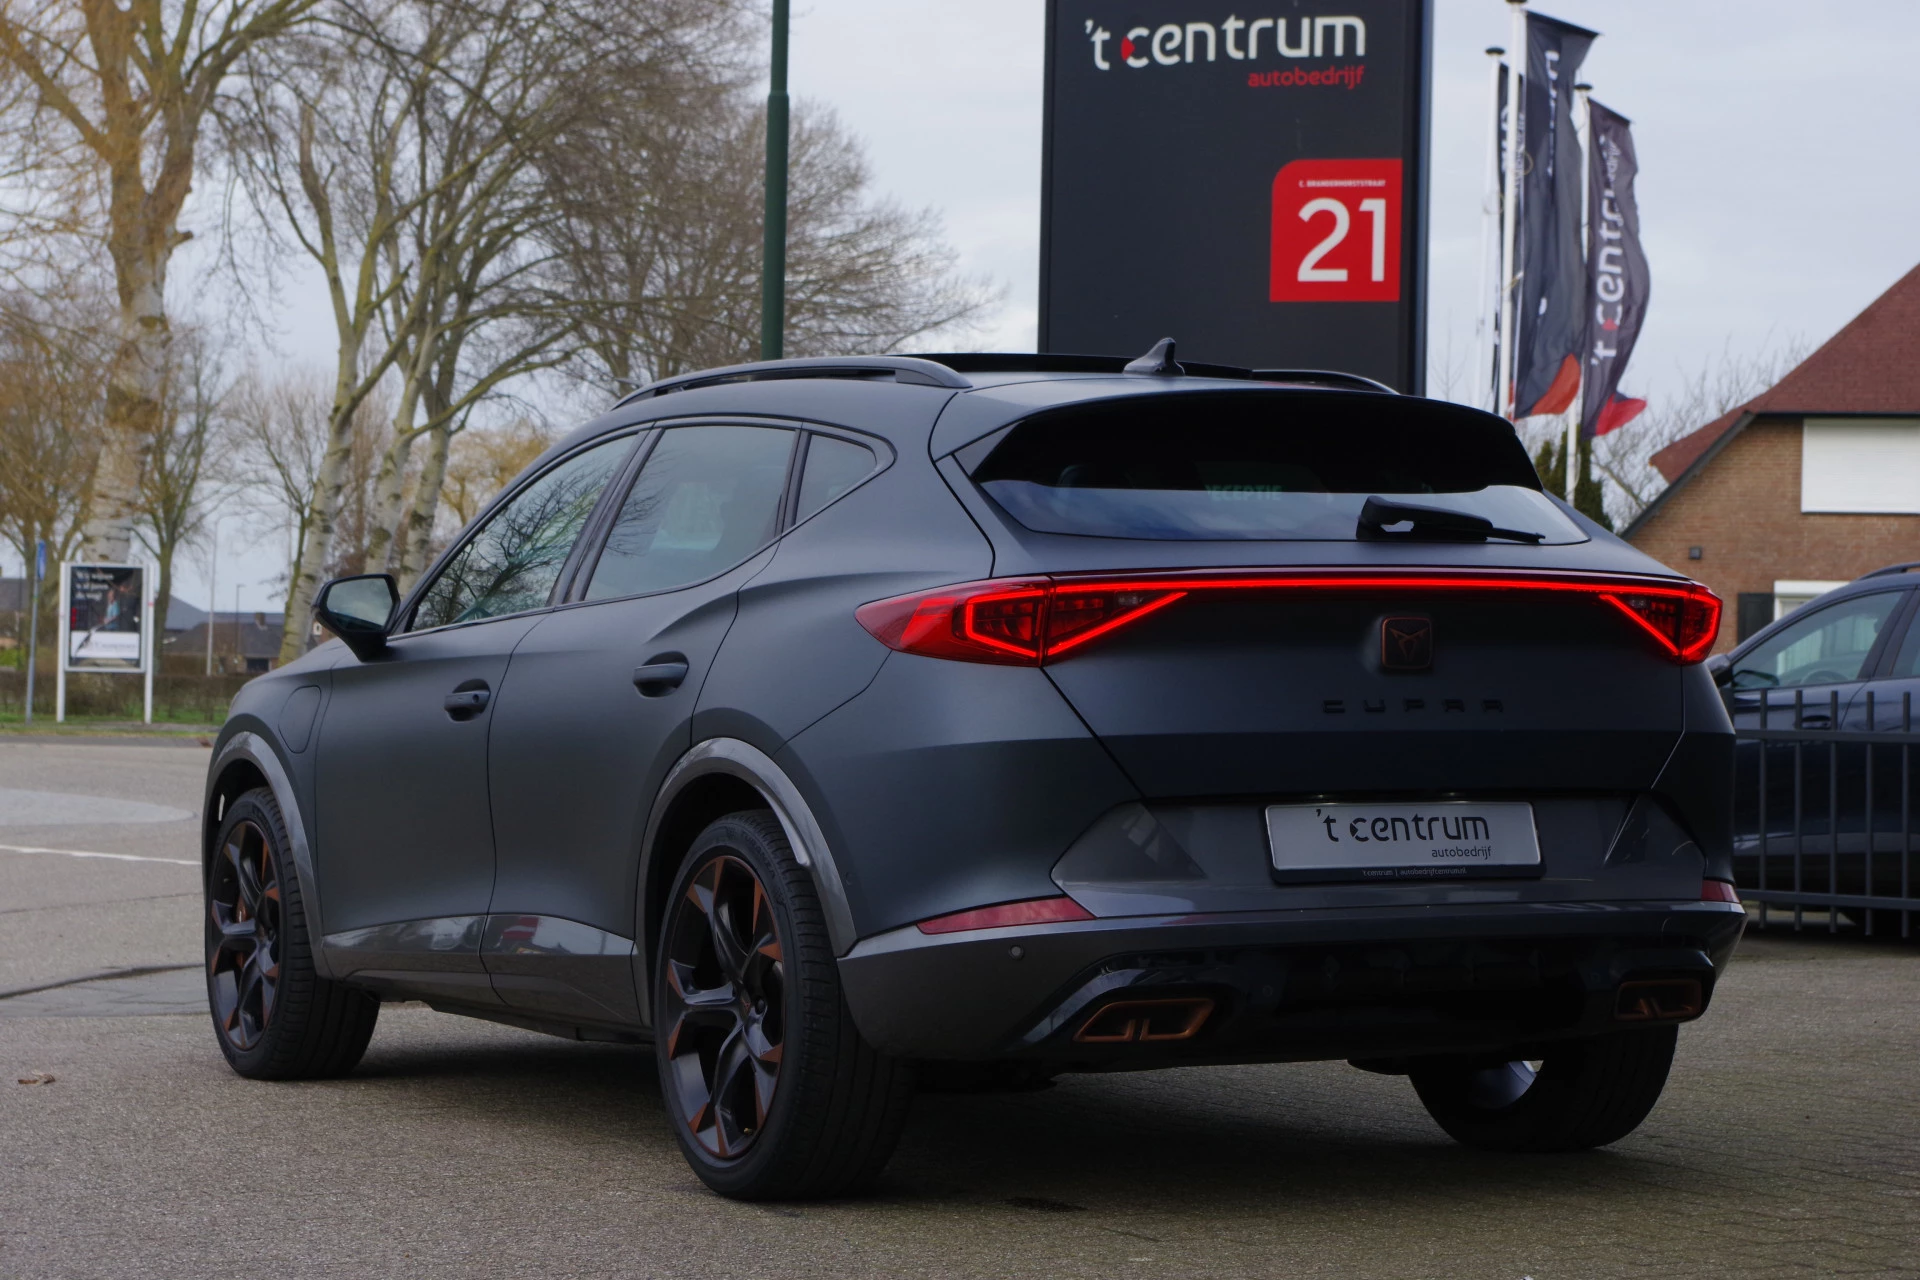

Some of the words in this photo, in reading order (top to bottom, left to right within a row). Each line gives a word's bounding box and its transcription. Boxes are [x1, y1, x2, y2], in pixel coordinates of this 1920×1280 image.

[1084, 19, 1111, 71] 't
[1120, 14, 1366, 69] centrum
[1247, 65, 1365, 90] autobedrijf
[1297, 197, 1387, 282] 21
[1322, 699, 1503, 713] CUPRA
[1315, 808, 1340, 842] 't
[1349, 812, 1491, 843] centrum
[1431, 845, 1492, 861] autobedrijf
